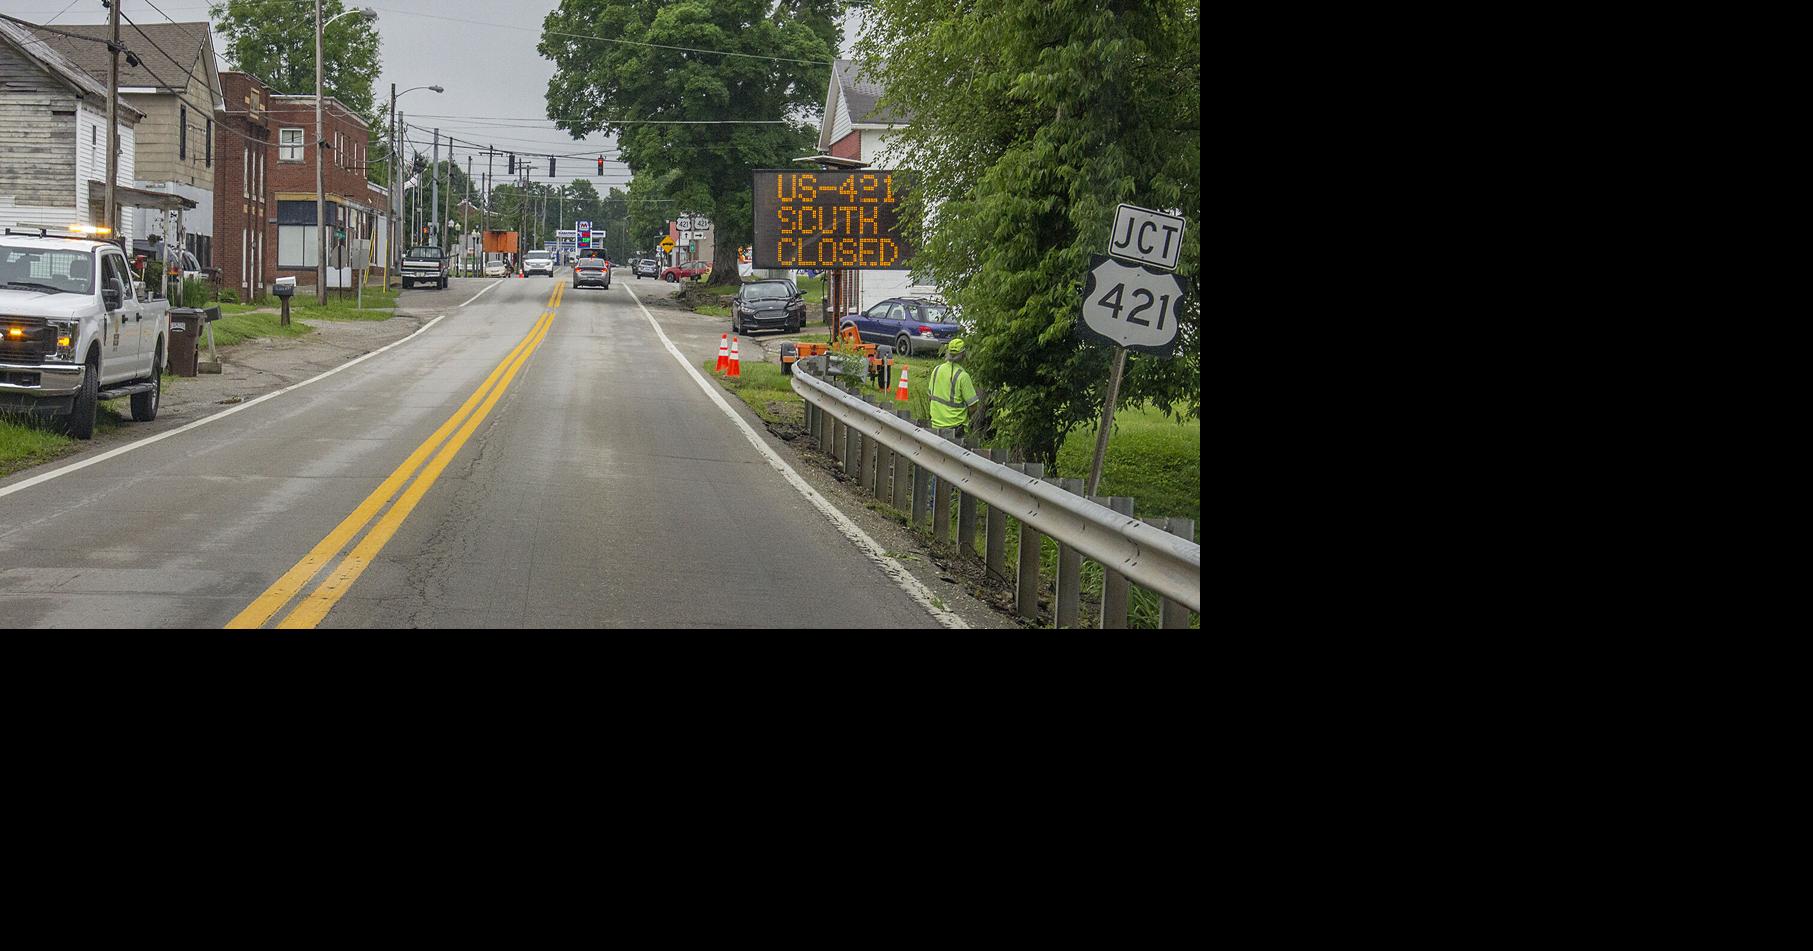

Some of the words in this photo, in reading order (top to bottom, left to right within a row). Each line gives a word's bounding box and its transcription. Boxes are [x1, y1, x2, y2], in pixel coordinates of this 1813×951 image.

[777, 174, 895, 203] US-421
[679, 220, 689, 228] 421
[1114, 217, 1179, 259] JCT
[777, 237, 899, 266] CLOSED
[1097, 282, 1170, 331] 421
